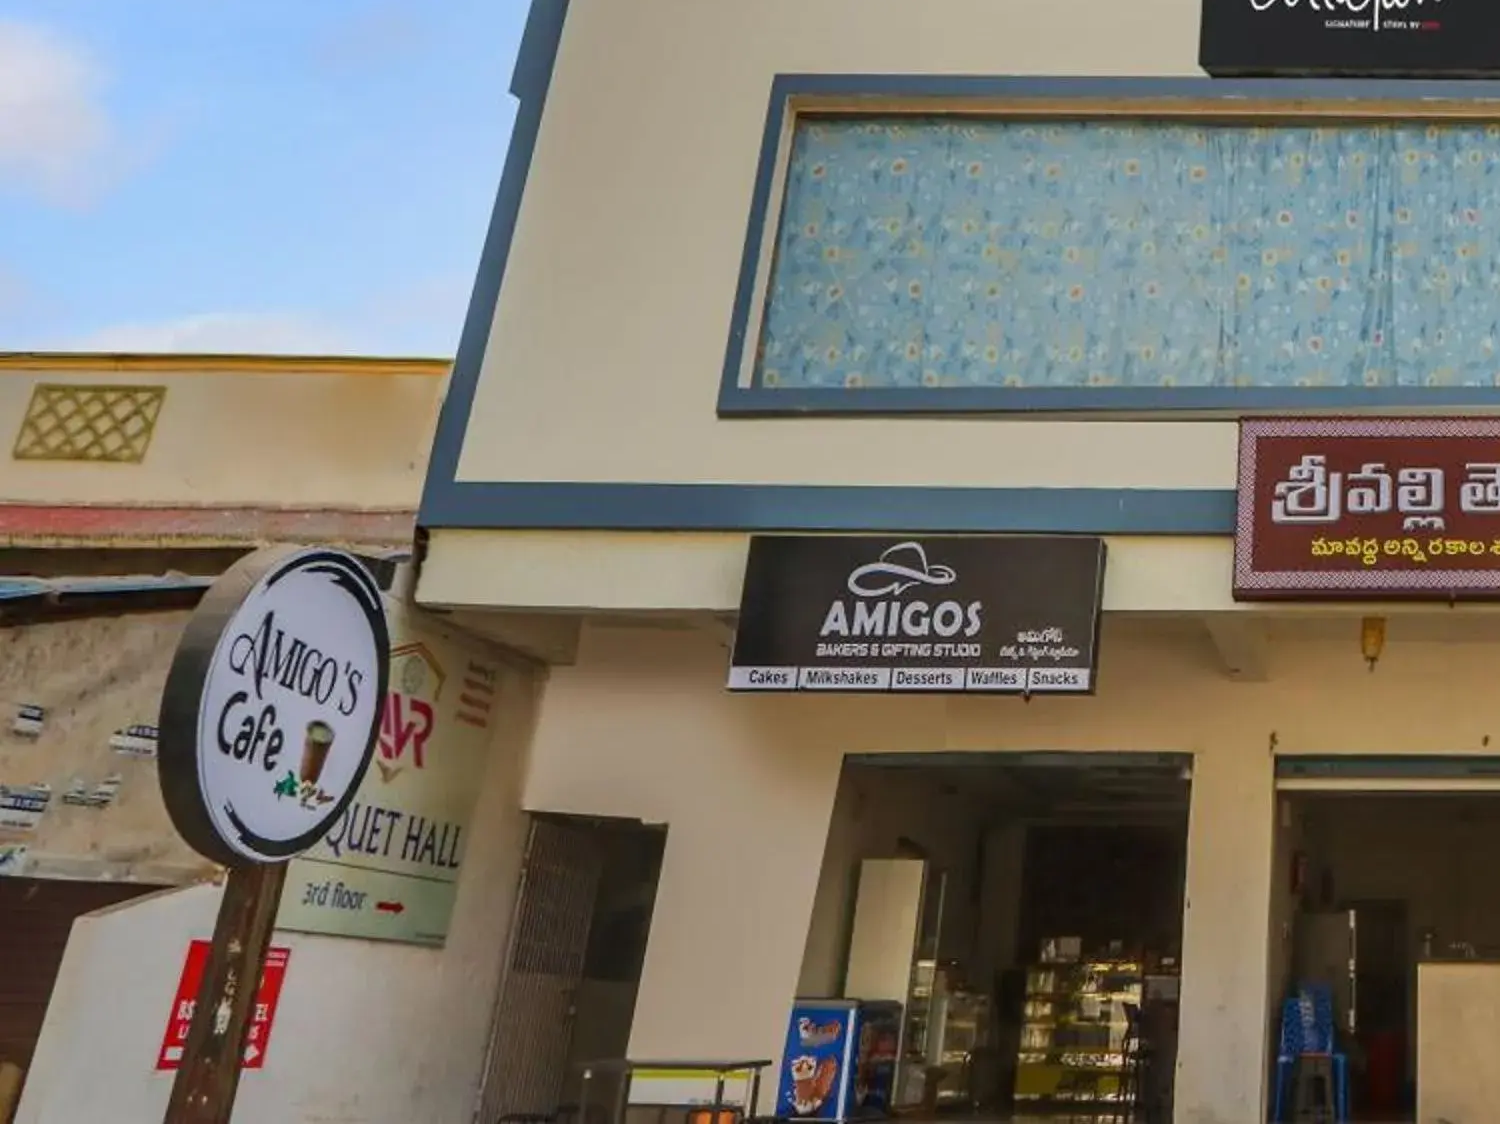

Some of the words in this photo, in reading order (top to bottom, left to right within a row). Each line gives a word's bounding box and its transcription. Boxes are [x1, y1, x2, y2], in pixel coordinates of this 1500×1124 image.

[1272, 455, 1445, 531] శ్రీవల్లి
[1384, 538, 1427, 562] అన్ని
[1429, 538, 1484, 556] రకాల
[819, 600, 981, 638] AMIGOS
[816, 643, 868, 657] BAKERS
[870, 644, 880, 657] &
[881, 644, 932, 657] GIFTING
[933, 644, 981, 657] STUDIO
[749, 670, 788, 684] Cakes
[806, 671, 878, 685] Milkshakes
[896, 672, 953, 685] Desserts
[971, 672, 1018, 685] Waffles
[1032, 672, 1078, 685] Snacks
[217, 691, 284, 772] Cafe
[326, 802, 402, 858] QUET
[401, 816, 461, 868] HALL
[331, 882, 368, 911] floor
